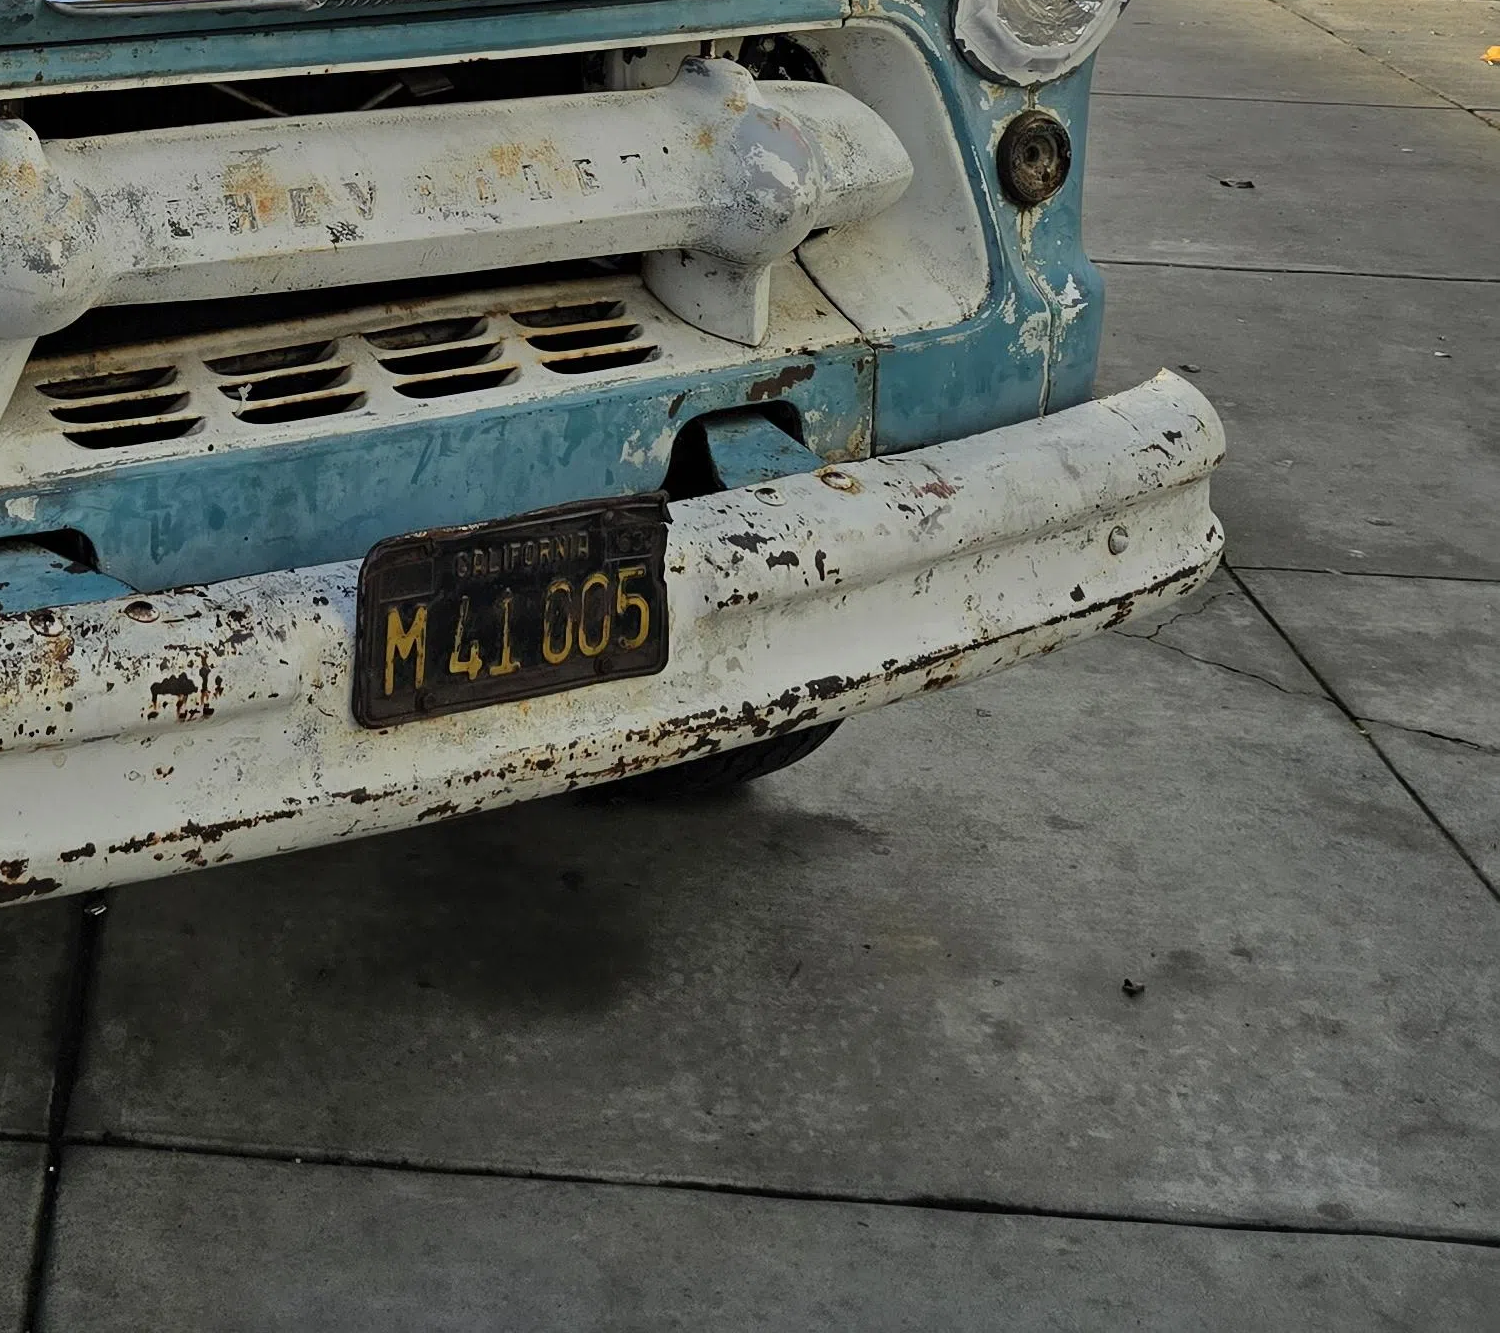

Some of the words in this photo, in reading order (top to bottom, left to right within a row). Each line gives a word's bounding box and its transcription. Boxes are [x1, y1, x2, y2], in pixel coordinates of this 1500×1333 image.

[454, 531, 590, 579] CALIFORNIA
[384, 602, 428, 697] M
[448, 586, 522, 681] 41
[541, 563, 650, 666] 005
